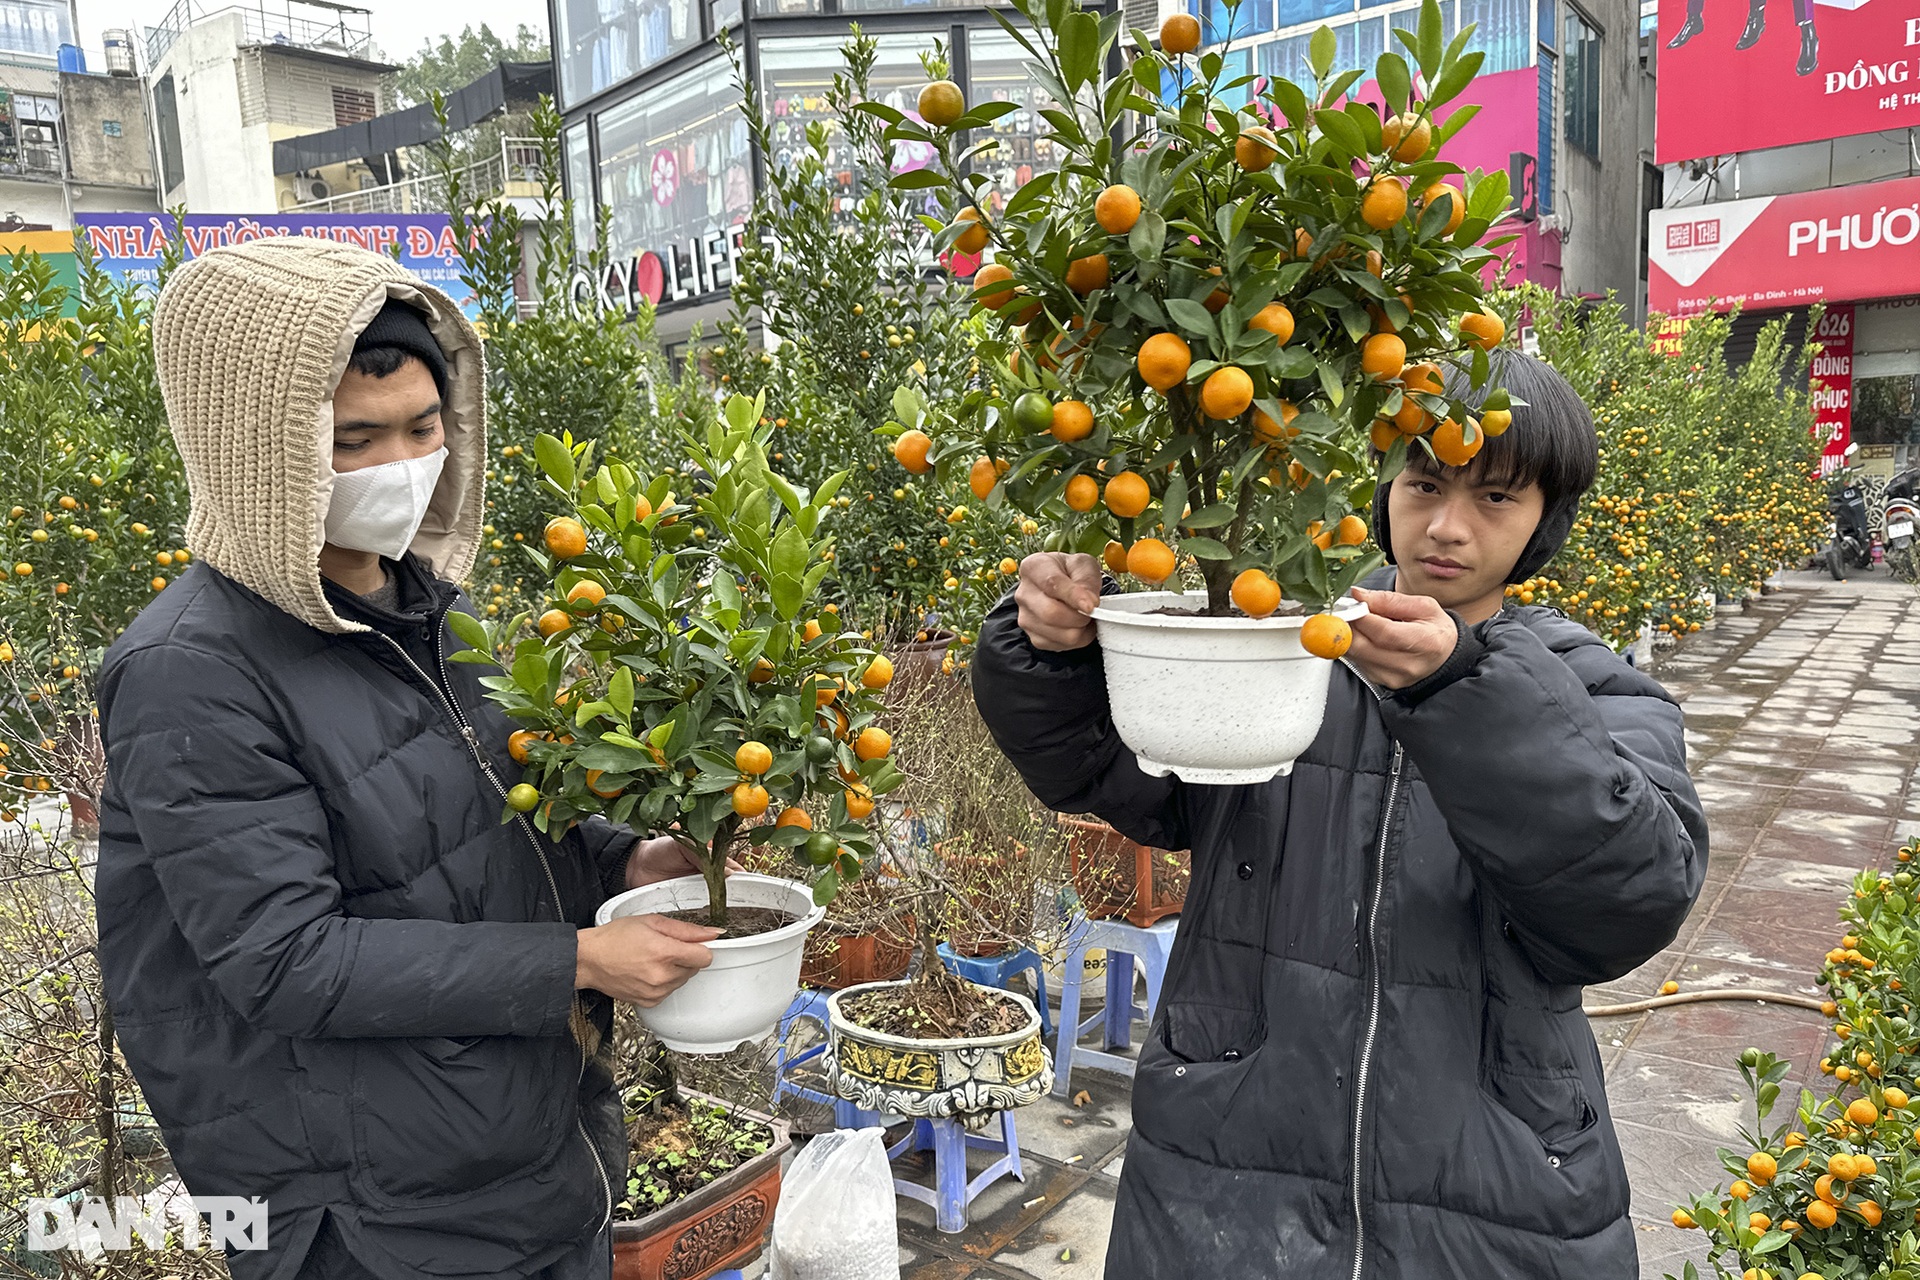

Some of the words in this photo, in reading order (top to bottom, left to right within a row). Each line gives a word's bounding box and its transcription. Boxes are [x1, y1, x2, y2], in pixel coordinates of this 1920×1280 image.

[1823, 59, 1910, 95] ĐỒNG
[1879, 93, 1899, 111] HỆ
[87, 216, 170, 260] NHÀ
[1788, 202, 1920, 257] PHƯƠ
[667, 223, 746, 302] LIFE
[1818, 312, 1850, 337] 626
[1812, 350, 1850, 377] ĐỒNG
